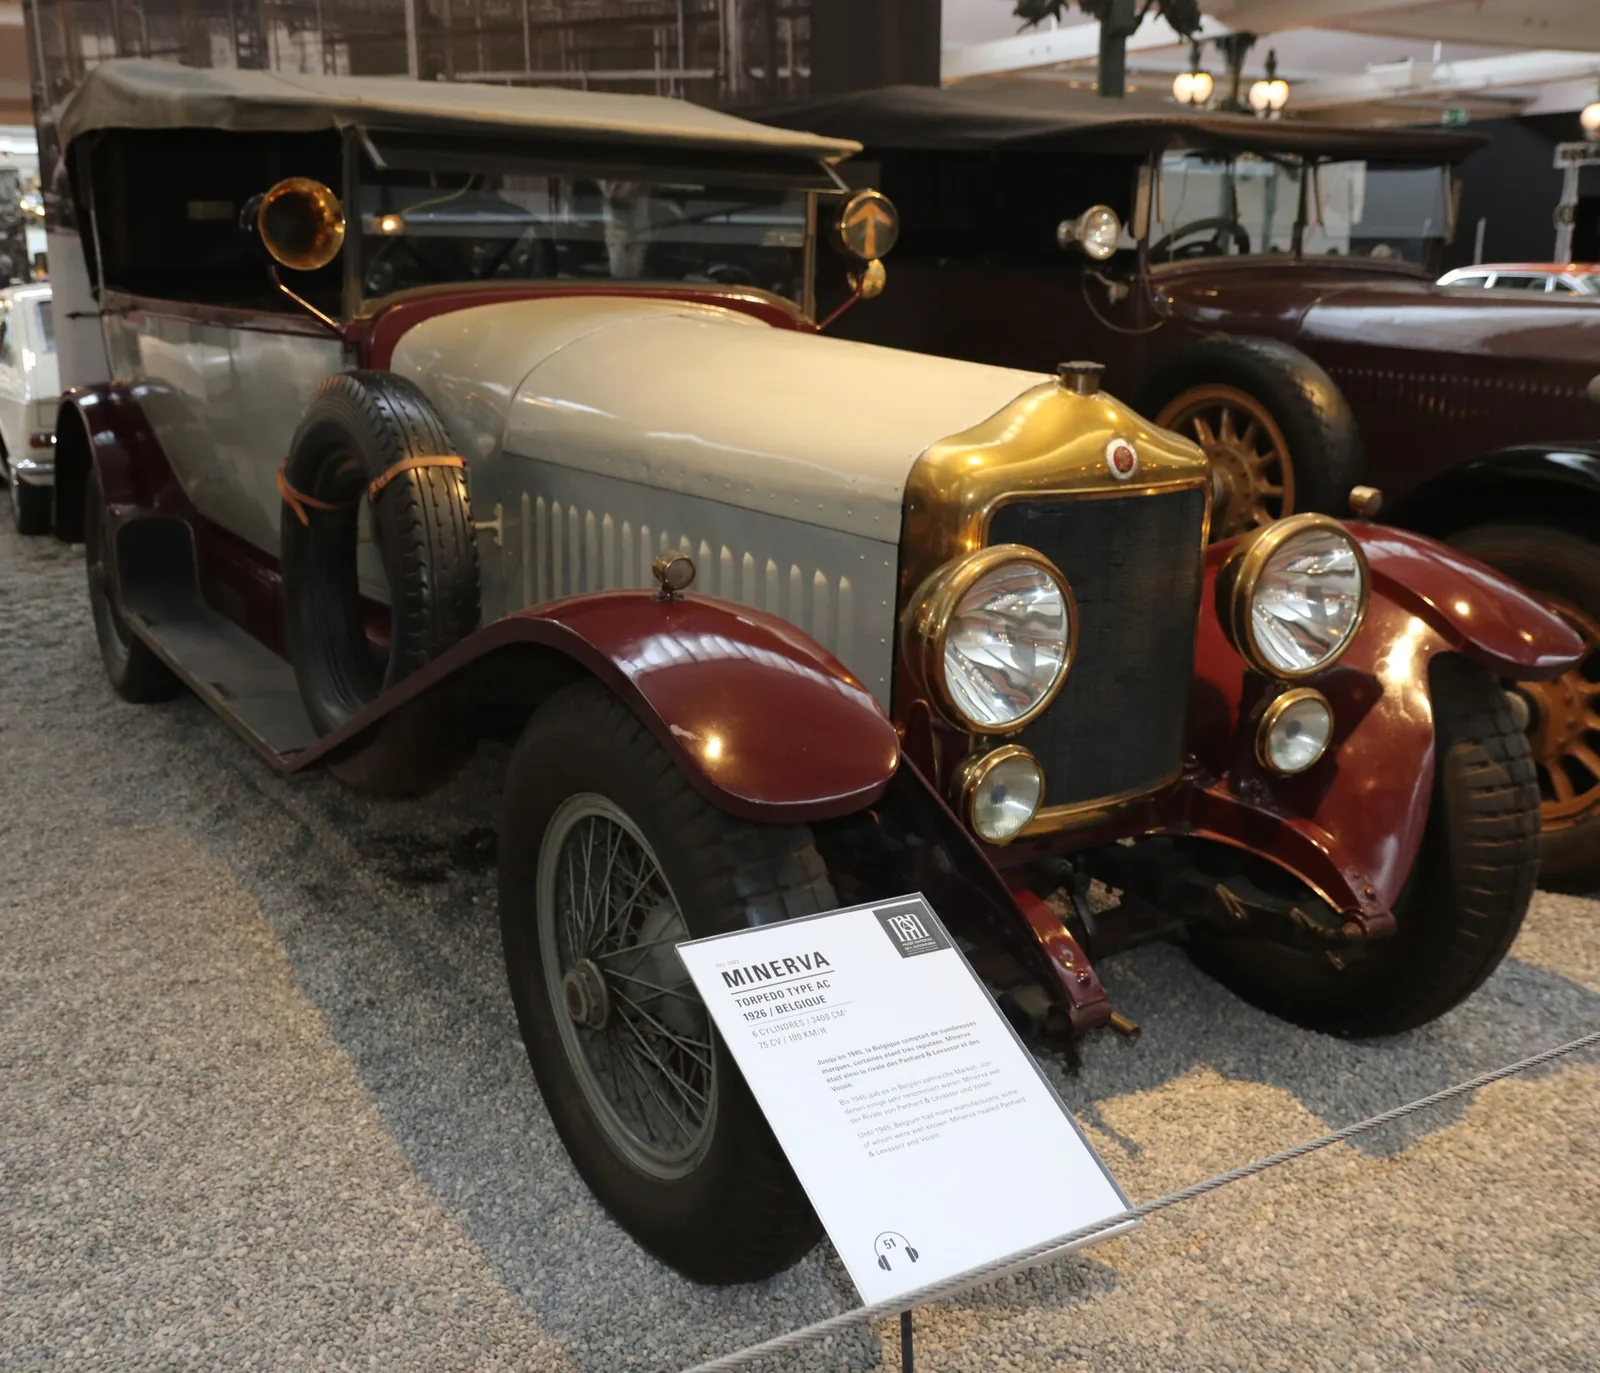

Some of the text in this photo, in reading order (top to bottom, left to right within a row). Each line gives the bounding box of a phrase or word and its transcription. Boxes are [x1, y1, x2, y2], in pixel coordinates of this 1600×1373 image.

[721, 951, 831, 988] MINERVA
[735, 979, 831, 1008] TORPEDO TYPE AC
[743, 995, 827, 1022] 1926 / BELGIQUE
[752, 1030, 759, 1038] 6
[759, 1019, 805, 1036] CYLINDRES
[806, 1018, 811, 1027] /
[810, 1013, 831, 1024] 3400
[758, 1027, 827, 1049] 75 CV / 100 KM/H
[872, 1041, 901, 1052] Belgique
[901, 1033, 930, 1044] comptait
[939, 1021, 977, 1034] nombreuses
[843, 1071, 860, 1079] ainsi
[867, 1064, 886, 1072] rivale
[898, 1053, 926, 1064] Panhard
[932, 1044, 960, 1056] Levassor
[853, 1055, 884, 1067] certaines
[944, 1032, 971, 1042] Minerva
[962, 1072, 989, 1083] Minerva
[989, 1068, 1000, 1076] war
[851, 1094, 868, 1103] 1945
[868, 1091, 881, 1100] gab
[897, 1080, 923, 1091] Belgien
[883, 1107, 897, 1115] von
[896, 1099, 924, 1111] Panhard
[960, 1086, 973, 1094] und
[863, 1140, 871, 1149] of
[872, 1136, 894, 1146] whom
[894, 1131, 911, 1140] were
[949, 1112, 977, 1123] Minerva
[999, 1097, 1026, 1108] Panhard
[893, 1117, 921, 1129] Belgium
[921, 1112, 935, 1120] had
[935, 1108, 953, 1117] many
[907, 1138, 920, 1147] and
[883, 1238, 896, 1250] 51
